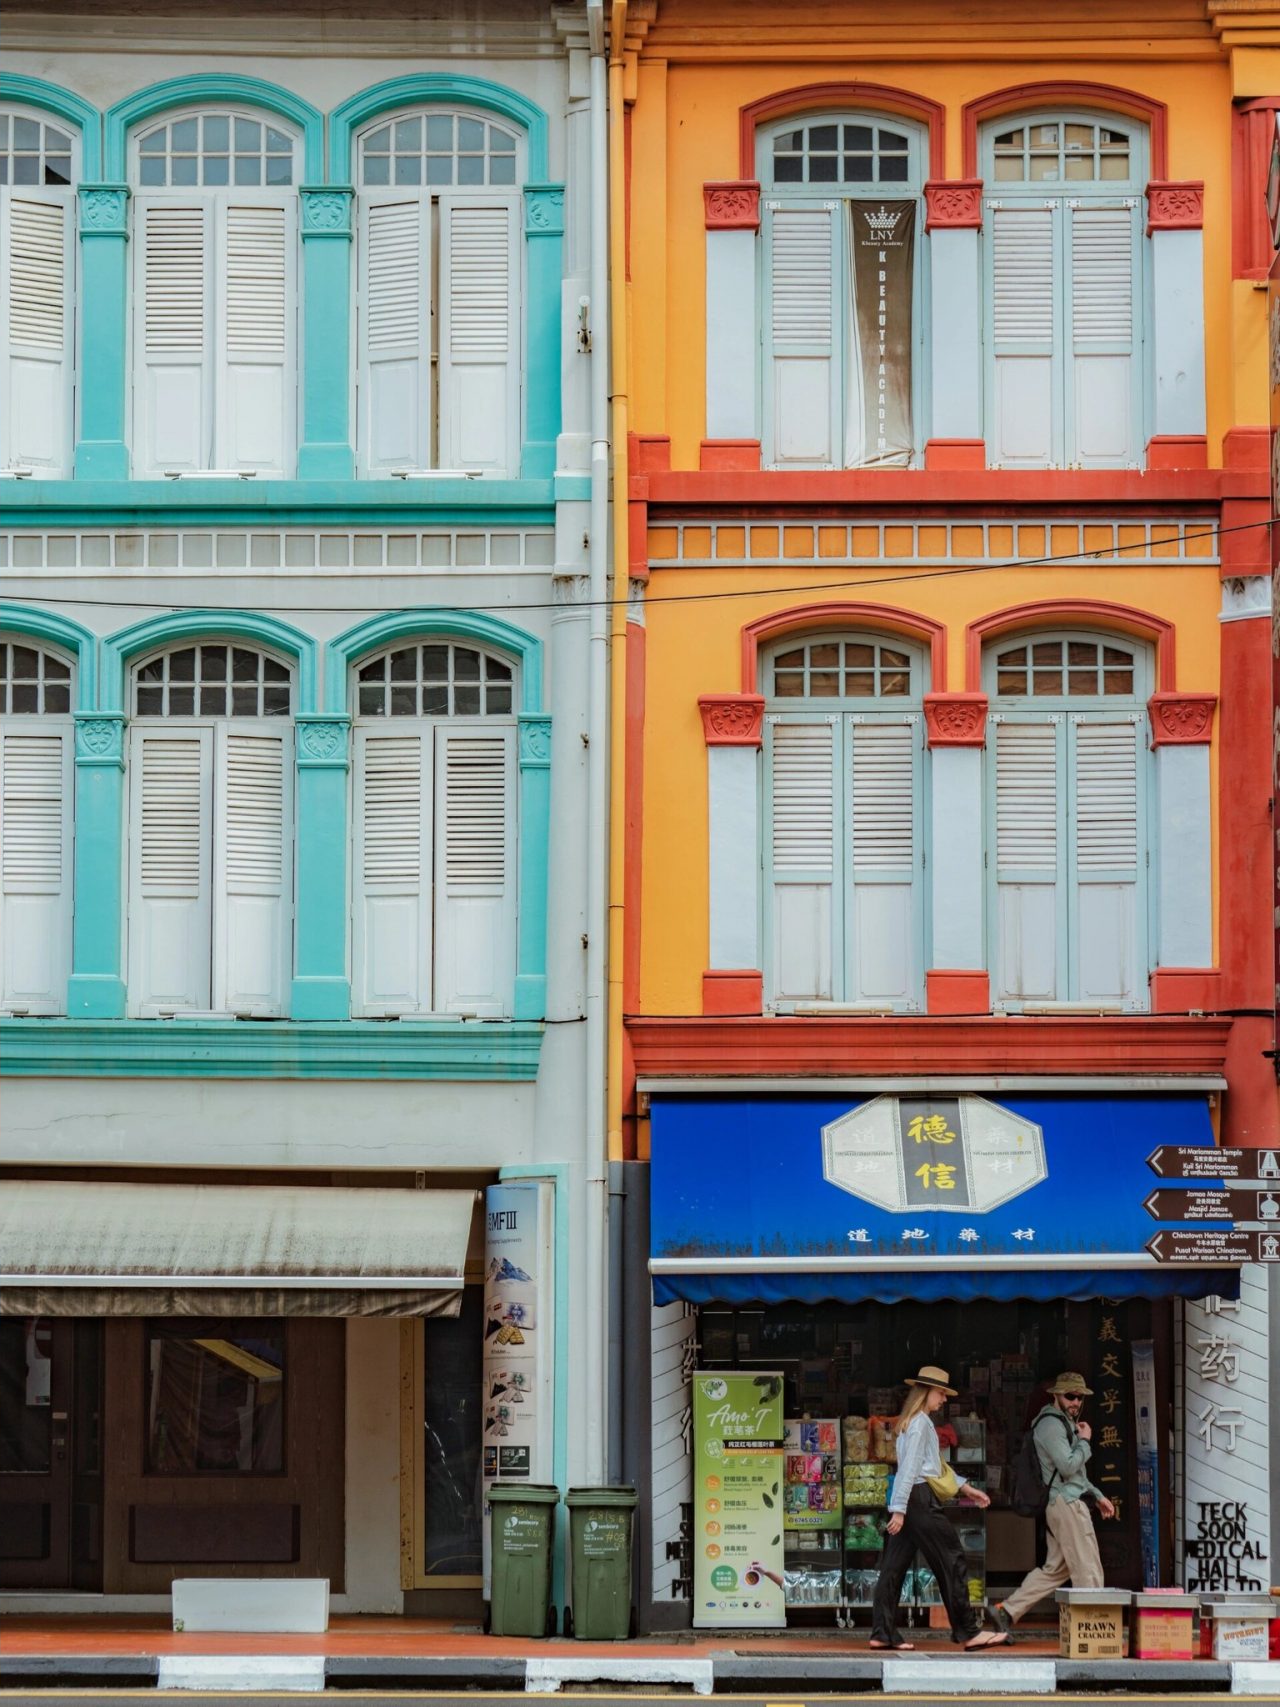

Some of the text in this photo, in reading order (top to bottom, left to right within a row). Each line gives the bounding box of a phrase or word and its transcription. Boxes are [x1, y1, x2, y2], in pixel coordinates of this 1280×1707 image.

[870, 230, 895, 241] LNY
[879, 251, 886, 262] K
[878, 270, 886, 356] BEAUTY
[907, 1114, 957, 1190] 德信
[1178, 1147, 1243, 1157] Sri Mariamman Temple
[1206, 1191, 1231, 1199] Mosque
[1188, 1205, 1208, 1213] Masjid
[1204, 1232, 1229, 1240] Heritage
[1098, 1297, 1123, 1521] 義交孚無二
[1197, 1502, 1247, 1522] TECK
[1197, 1520, 1247, 1541] SOON
[1185, 1540, 1268, 1560] MEDICAL
[1198, 1559, 1248, 1579] HALL
[1078, 1622, 1116, 1631] PRAWN
